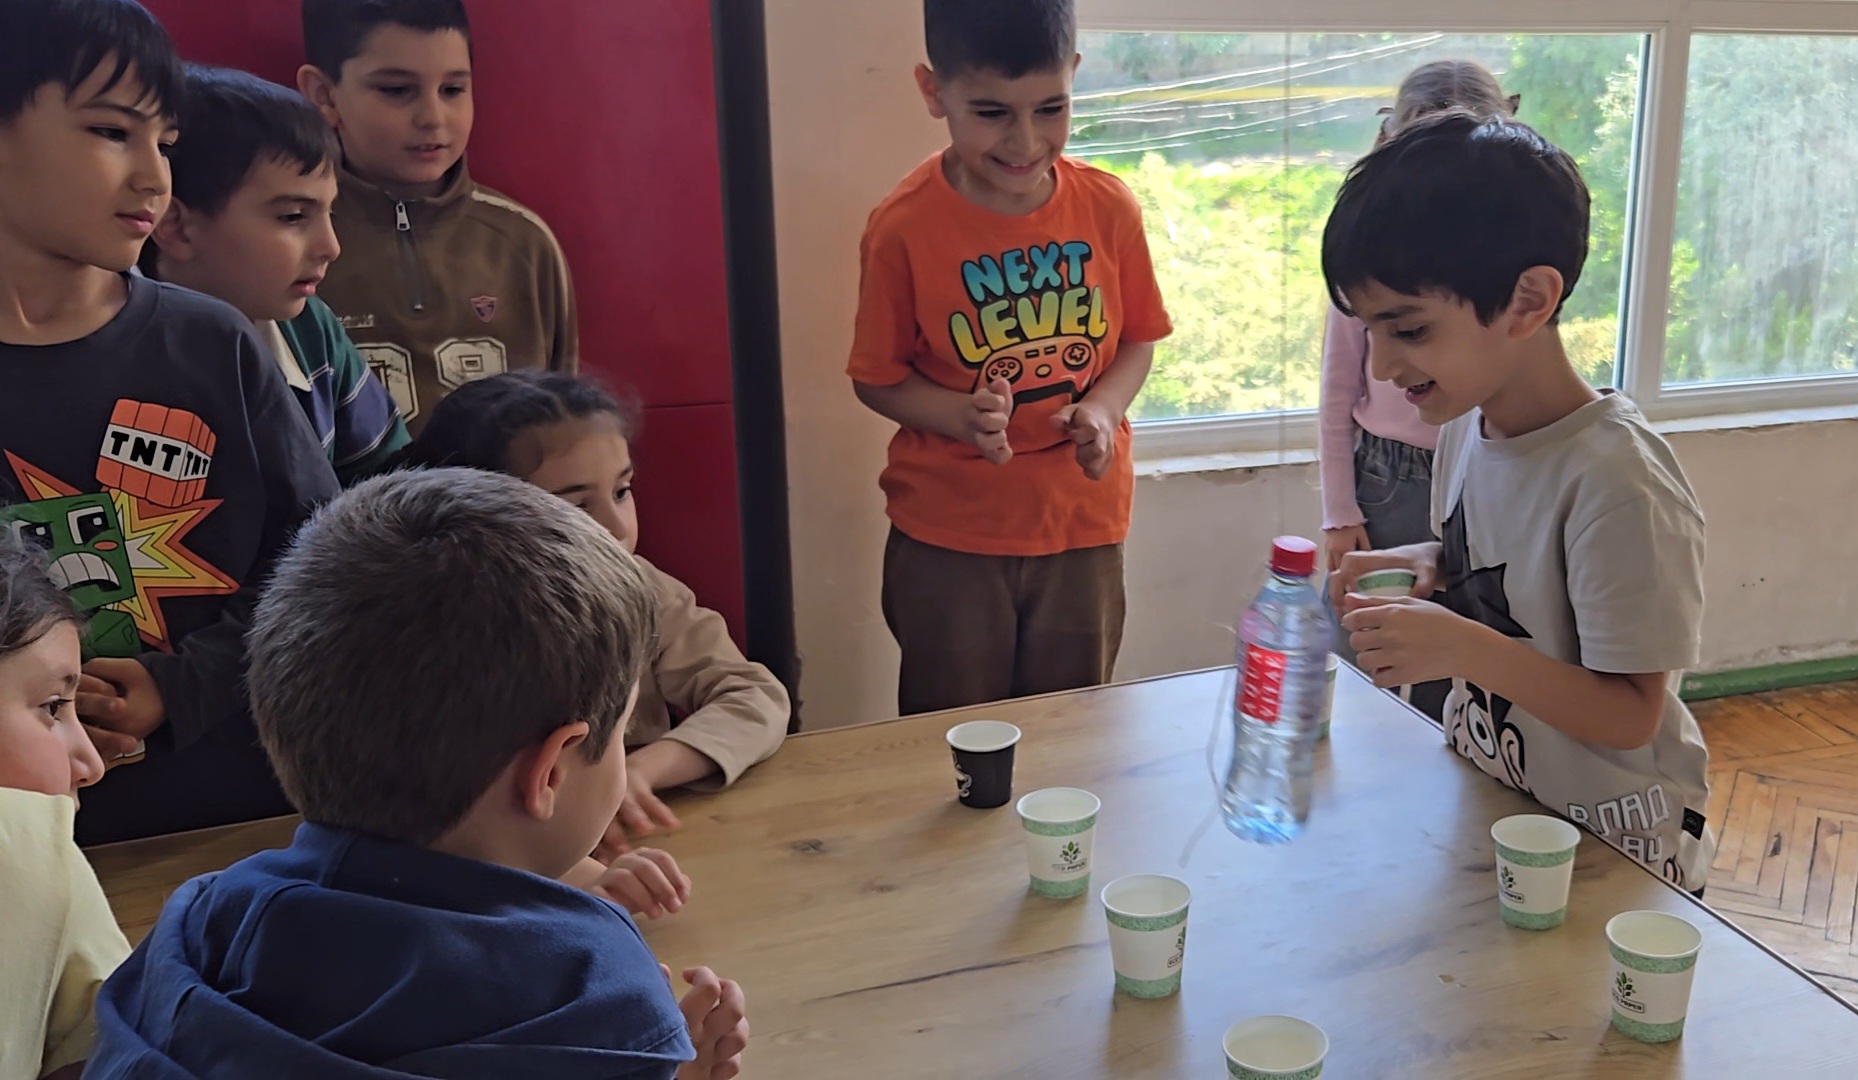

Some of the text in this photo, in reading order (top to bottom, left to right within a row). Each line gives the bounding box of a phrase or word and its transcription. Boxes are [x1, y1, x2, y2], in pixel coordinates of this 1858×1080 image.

[961, 241, 1092, 306] NEXT
[949, 286, 1108, 368] LEVEL
[110, 430, 182, 472] TNT
[183, 450, 209, 477] TNT
